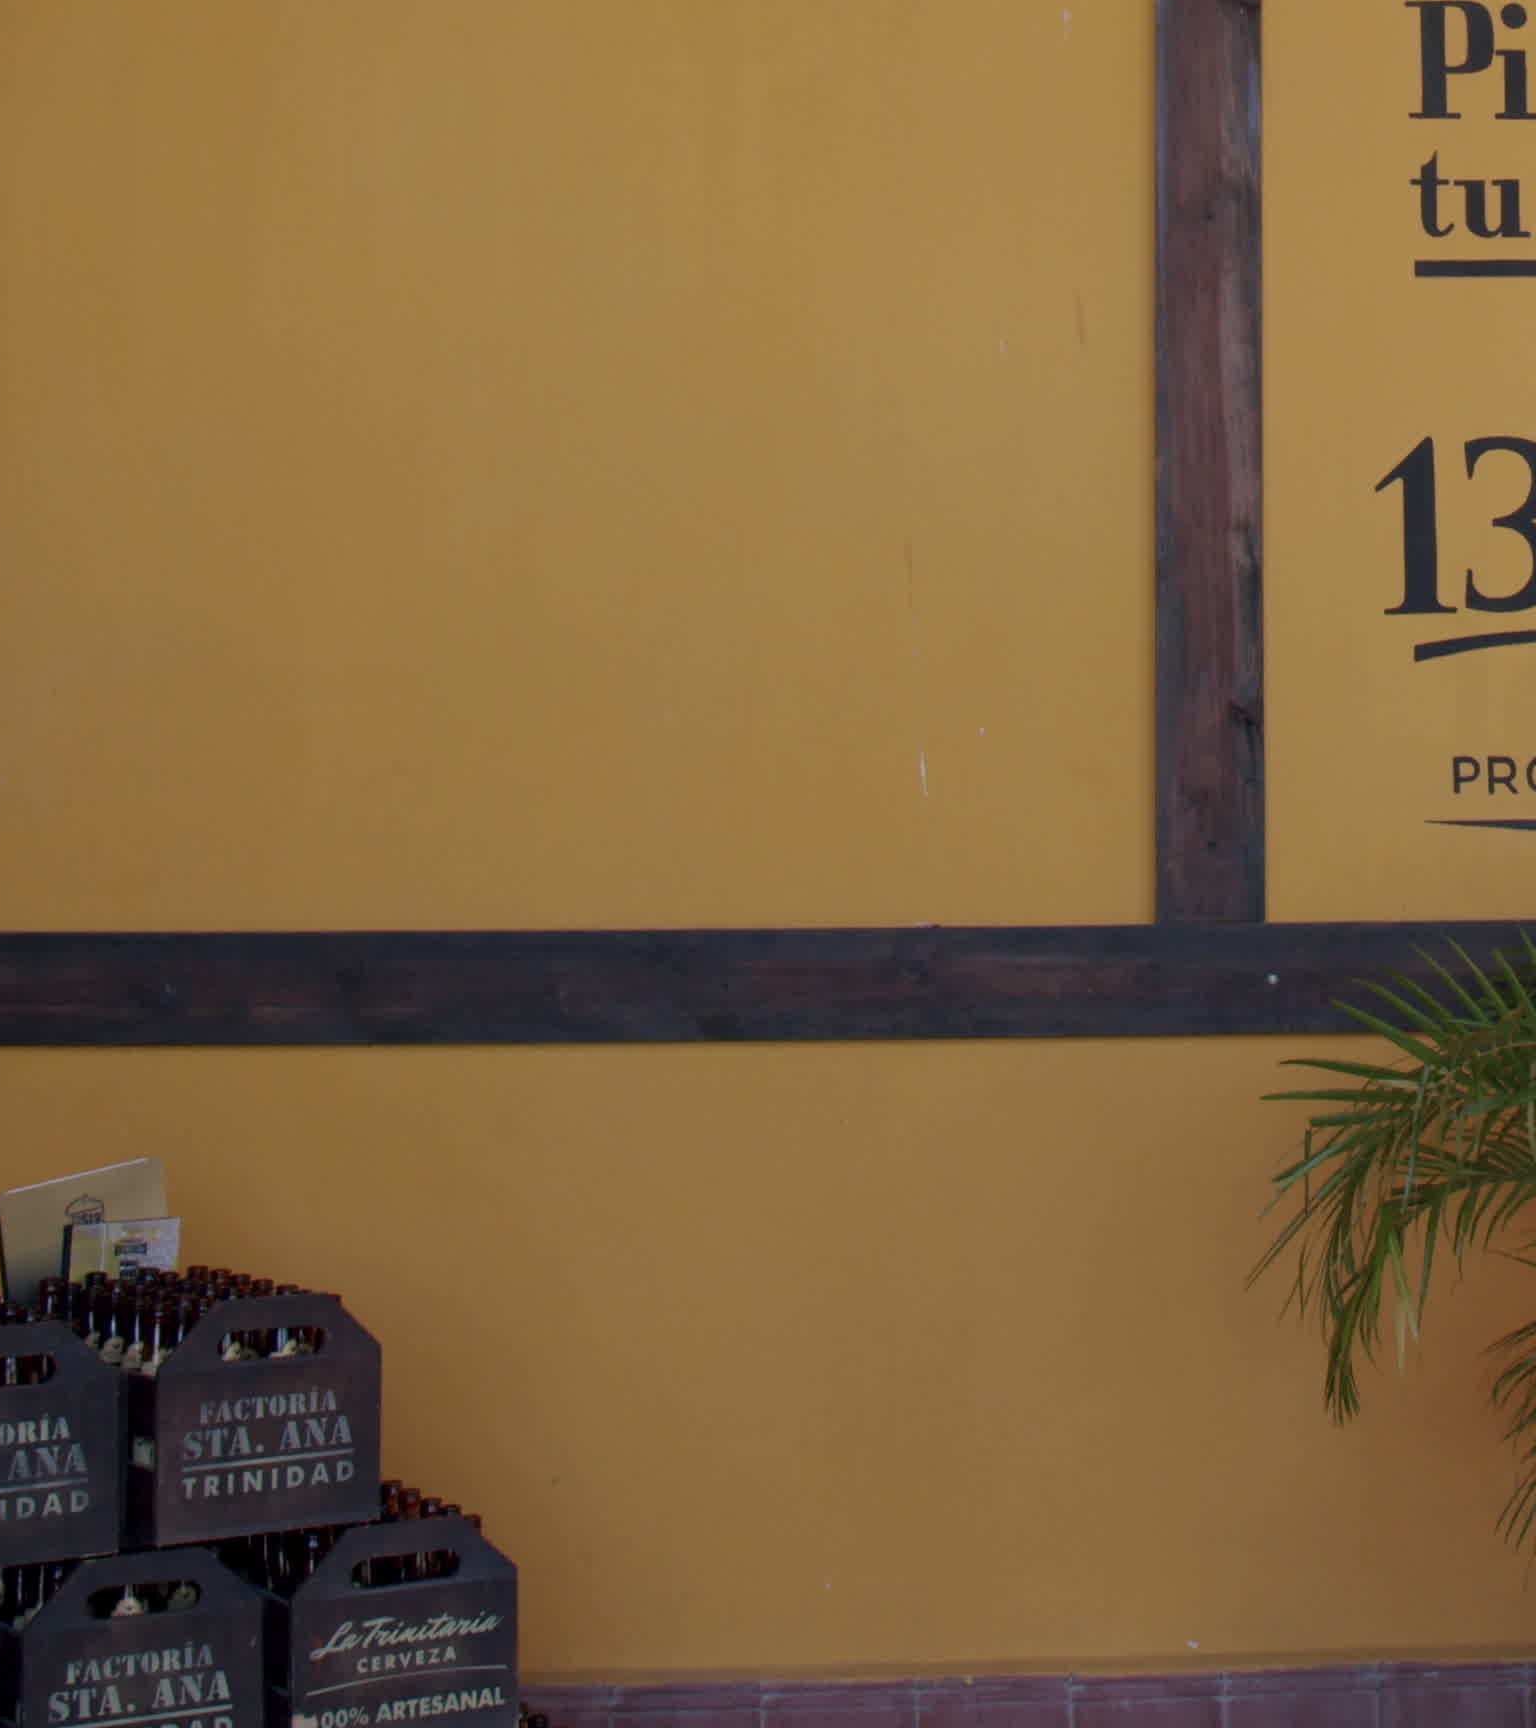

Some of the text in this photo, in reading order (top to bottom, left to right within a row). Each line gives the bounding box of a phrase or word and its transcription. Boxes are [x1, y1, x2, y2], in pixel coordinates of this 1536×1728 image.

[1409, 148, 1532, 239] tu
[200, 1385, 338, 1425] FACTORÍA
[183, 1415, 354, 1461] STA. ANA
[7, 1443, 89, 1481] ANA
[181, 1459, 355, 1501] TRINIDAD
[309, 1610, 504, 1662] La Trinitaria
[64, 1640, 215, 1686] FACTORÍA
[355, 1645, 458, 1674] CERVEZA
[48, 1669, 232, 1724] STA. ANA
[375, 1686, 506, 1724] ARTESANAL
